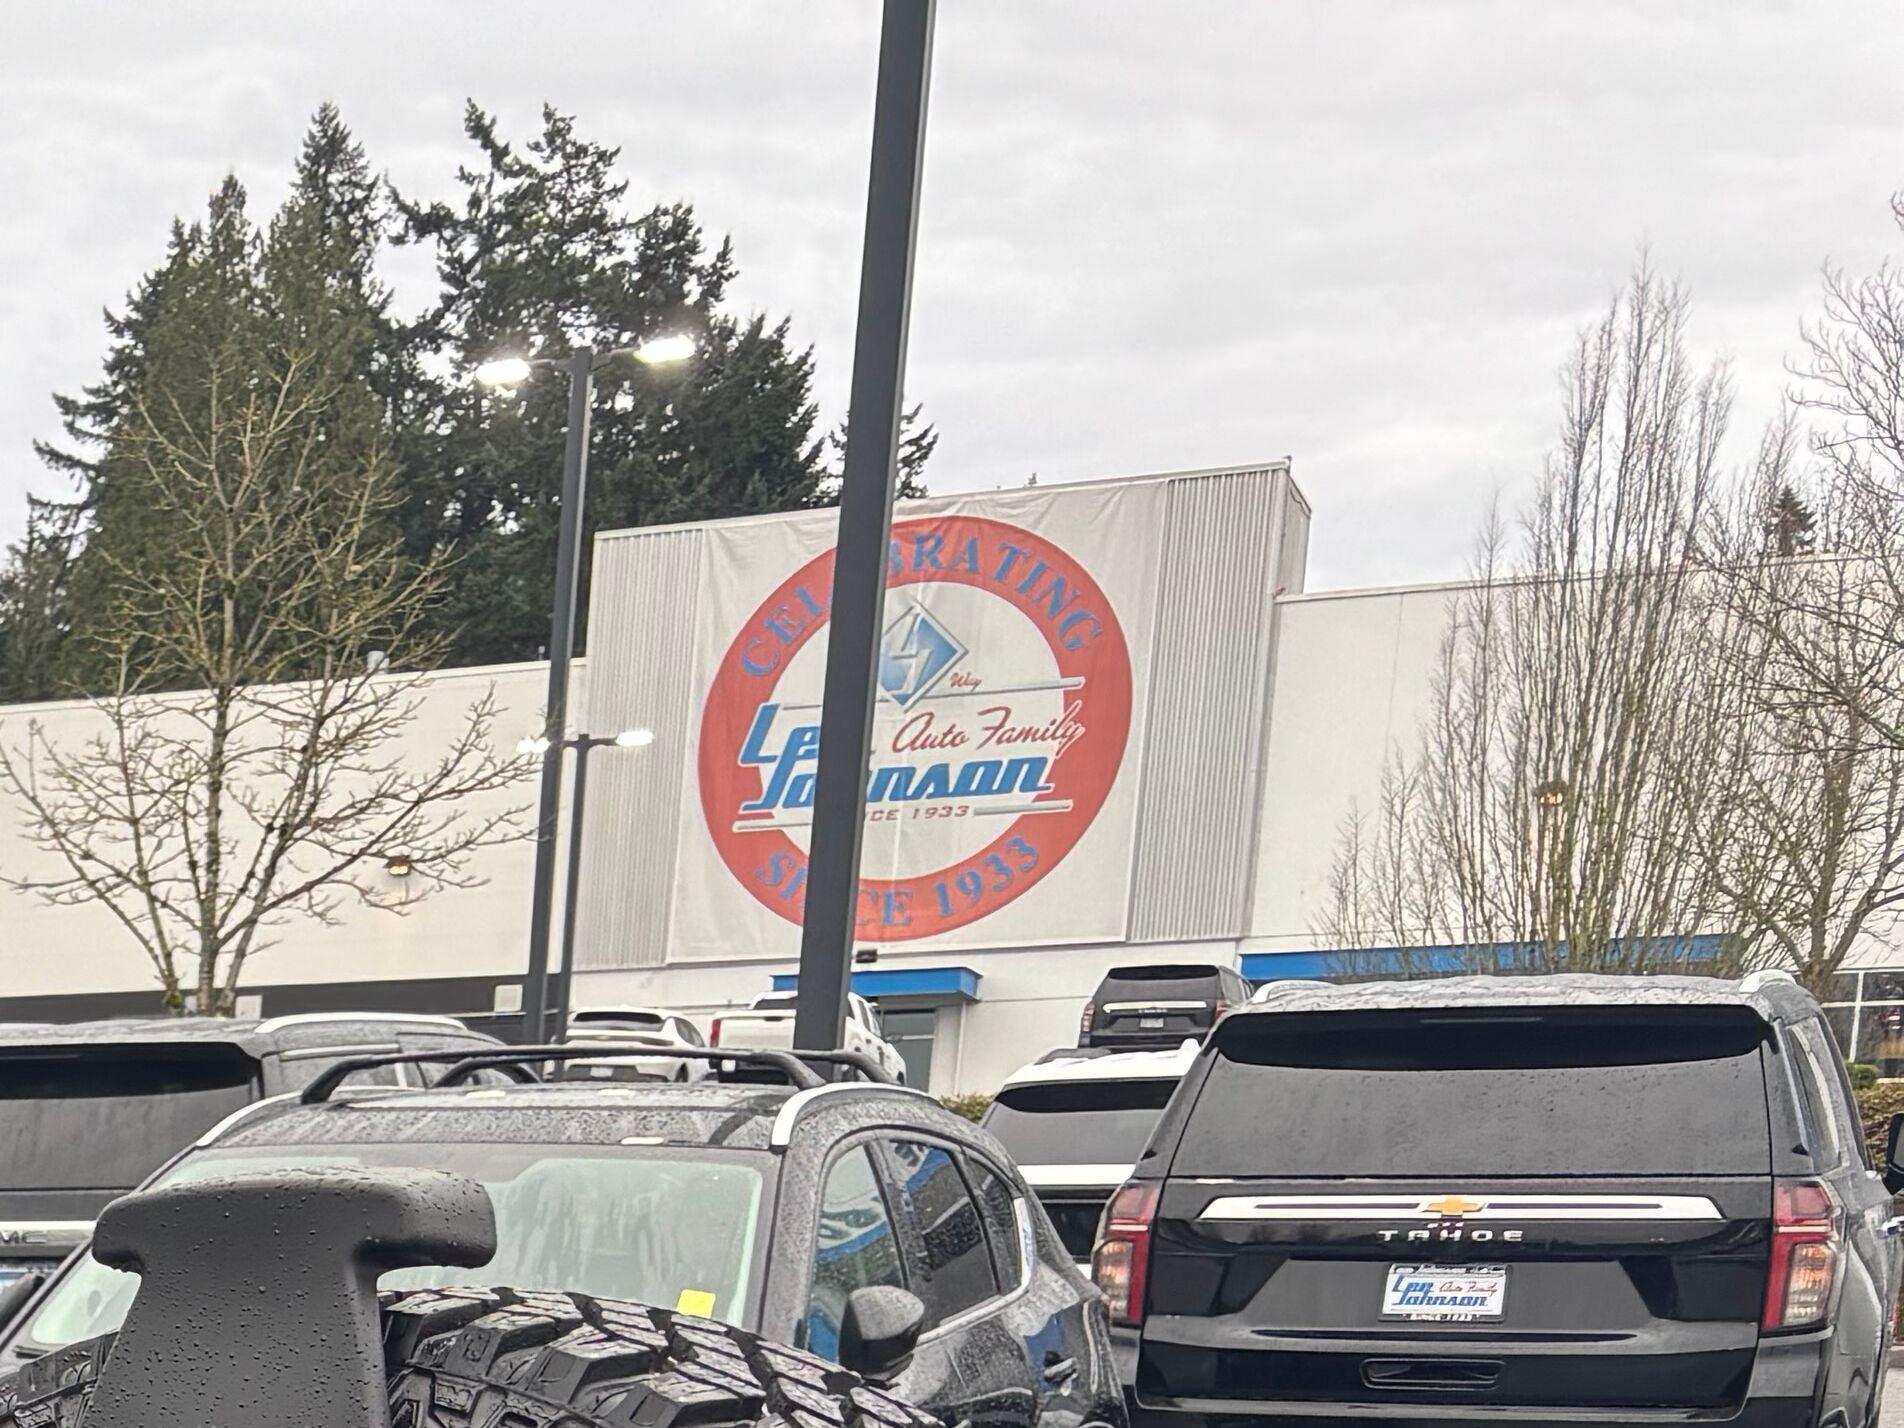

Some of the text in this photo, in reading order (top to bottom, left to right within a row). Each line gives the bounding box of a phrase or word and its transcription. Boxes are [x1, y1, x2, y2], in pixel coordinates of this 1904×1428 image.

[740, 700, 1085, 764] Le Auto Family
[741, 748, 1053, 812] Jonson
[911, 804, 970, 820] 1933
[934, 836, 1040, 918] 1933
[1376, 1229, 1524, 1242] TAHOE
